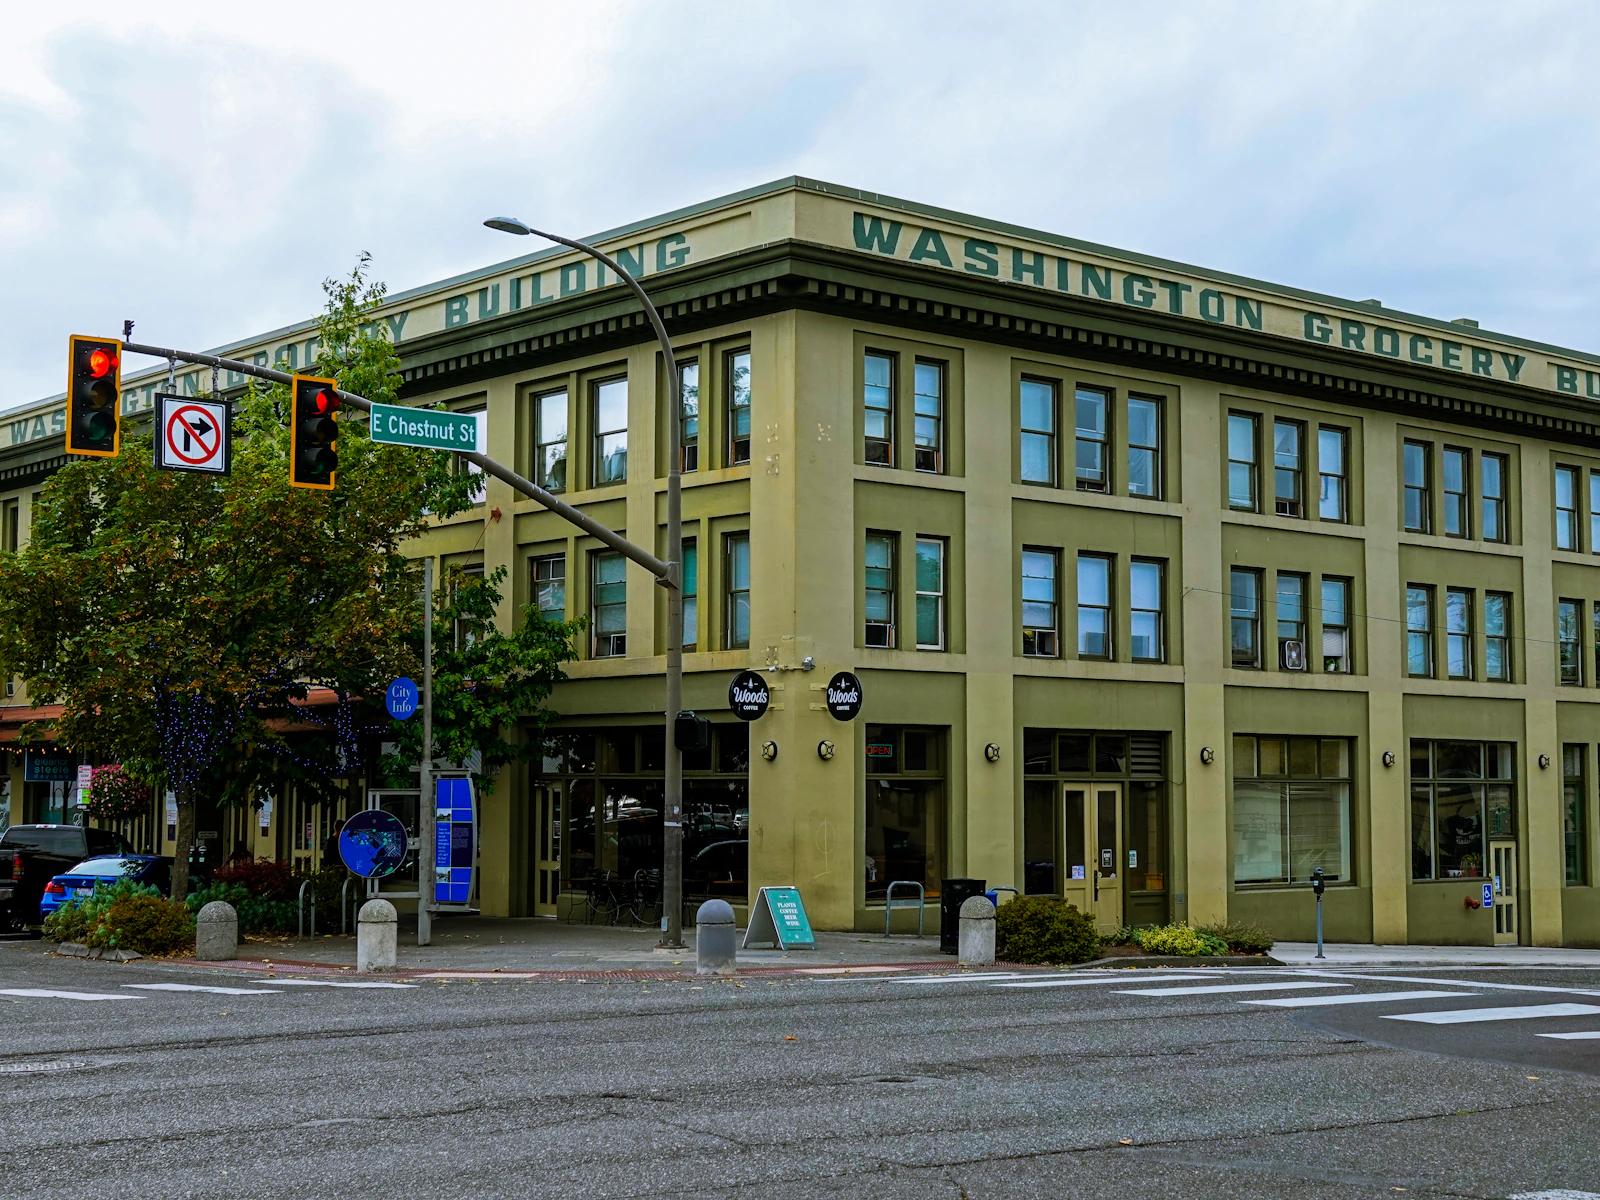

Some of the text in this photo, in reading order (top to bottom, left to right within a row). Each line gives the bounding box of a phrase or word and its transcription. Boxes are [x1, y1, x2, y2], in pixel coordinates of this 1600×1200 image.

[445, 232, 691, 330] BUILDING
[851, 211, 1263, 331] WASHINGTON
[1303, 311, 1527, 382] GROCERY
[373, 413, 475, 443] E Chestnut St
[391, 685, 411, 702] City
[733, 686, 768, 704] Woods
[828, 687, 859, 704] Woods
[392, 700, 412, 712] Info
[866, 745, 891, 755] OPEN
[34, 758, 70, 766] eleanor
[34, 765, 69, 774] steele
